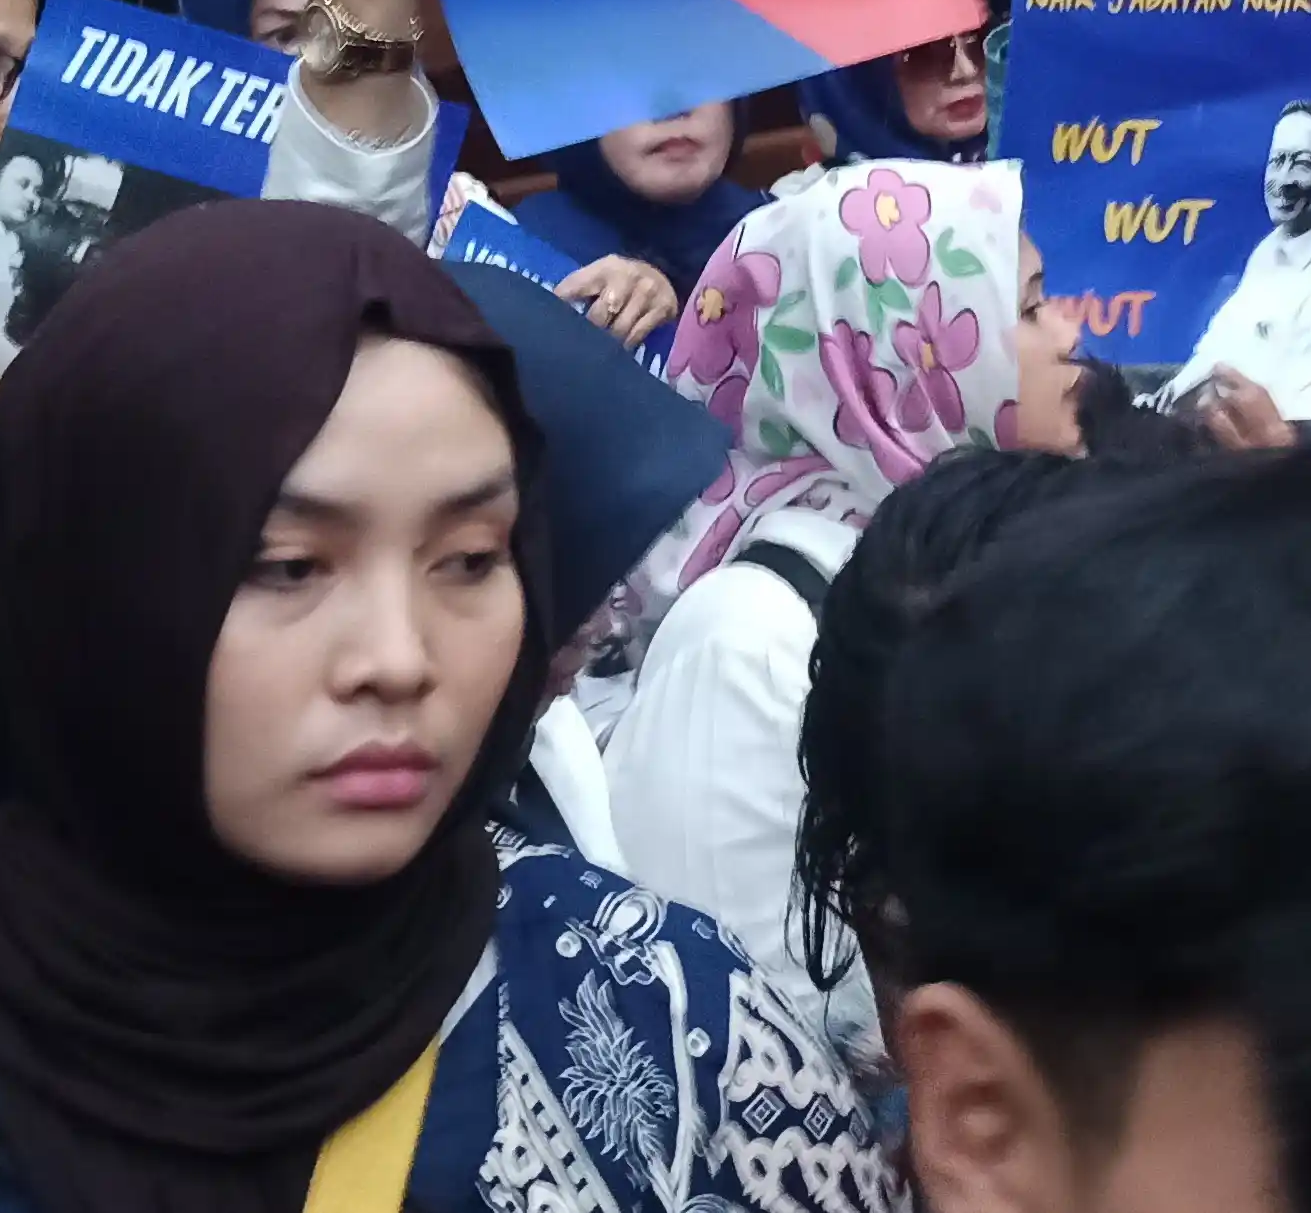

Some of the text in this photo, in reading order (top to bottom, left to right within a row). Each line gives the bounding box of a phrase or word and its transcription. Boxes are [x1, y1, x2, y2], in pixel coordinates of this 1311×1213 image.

[61, 26, 288, 145] TIDAK TER
[1052, 115, 1163, 166] WUT
[1104, 193, 1217, 245] WUT
